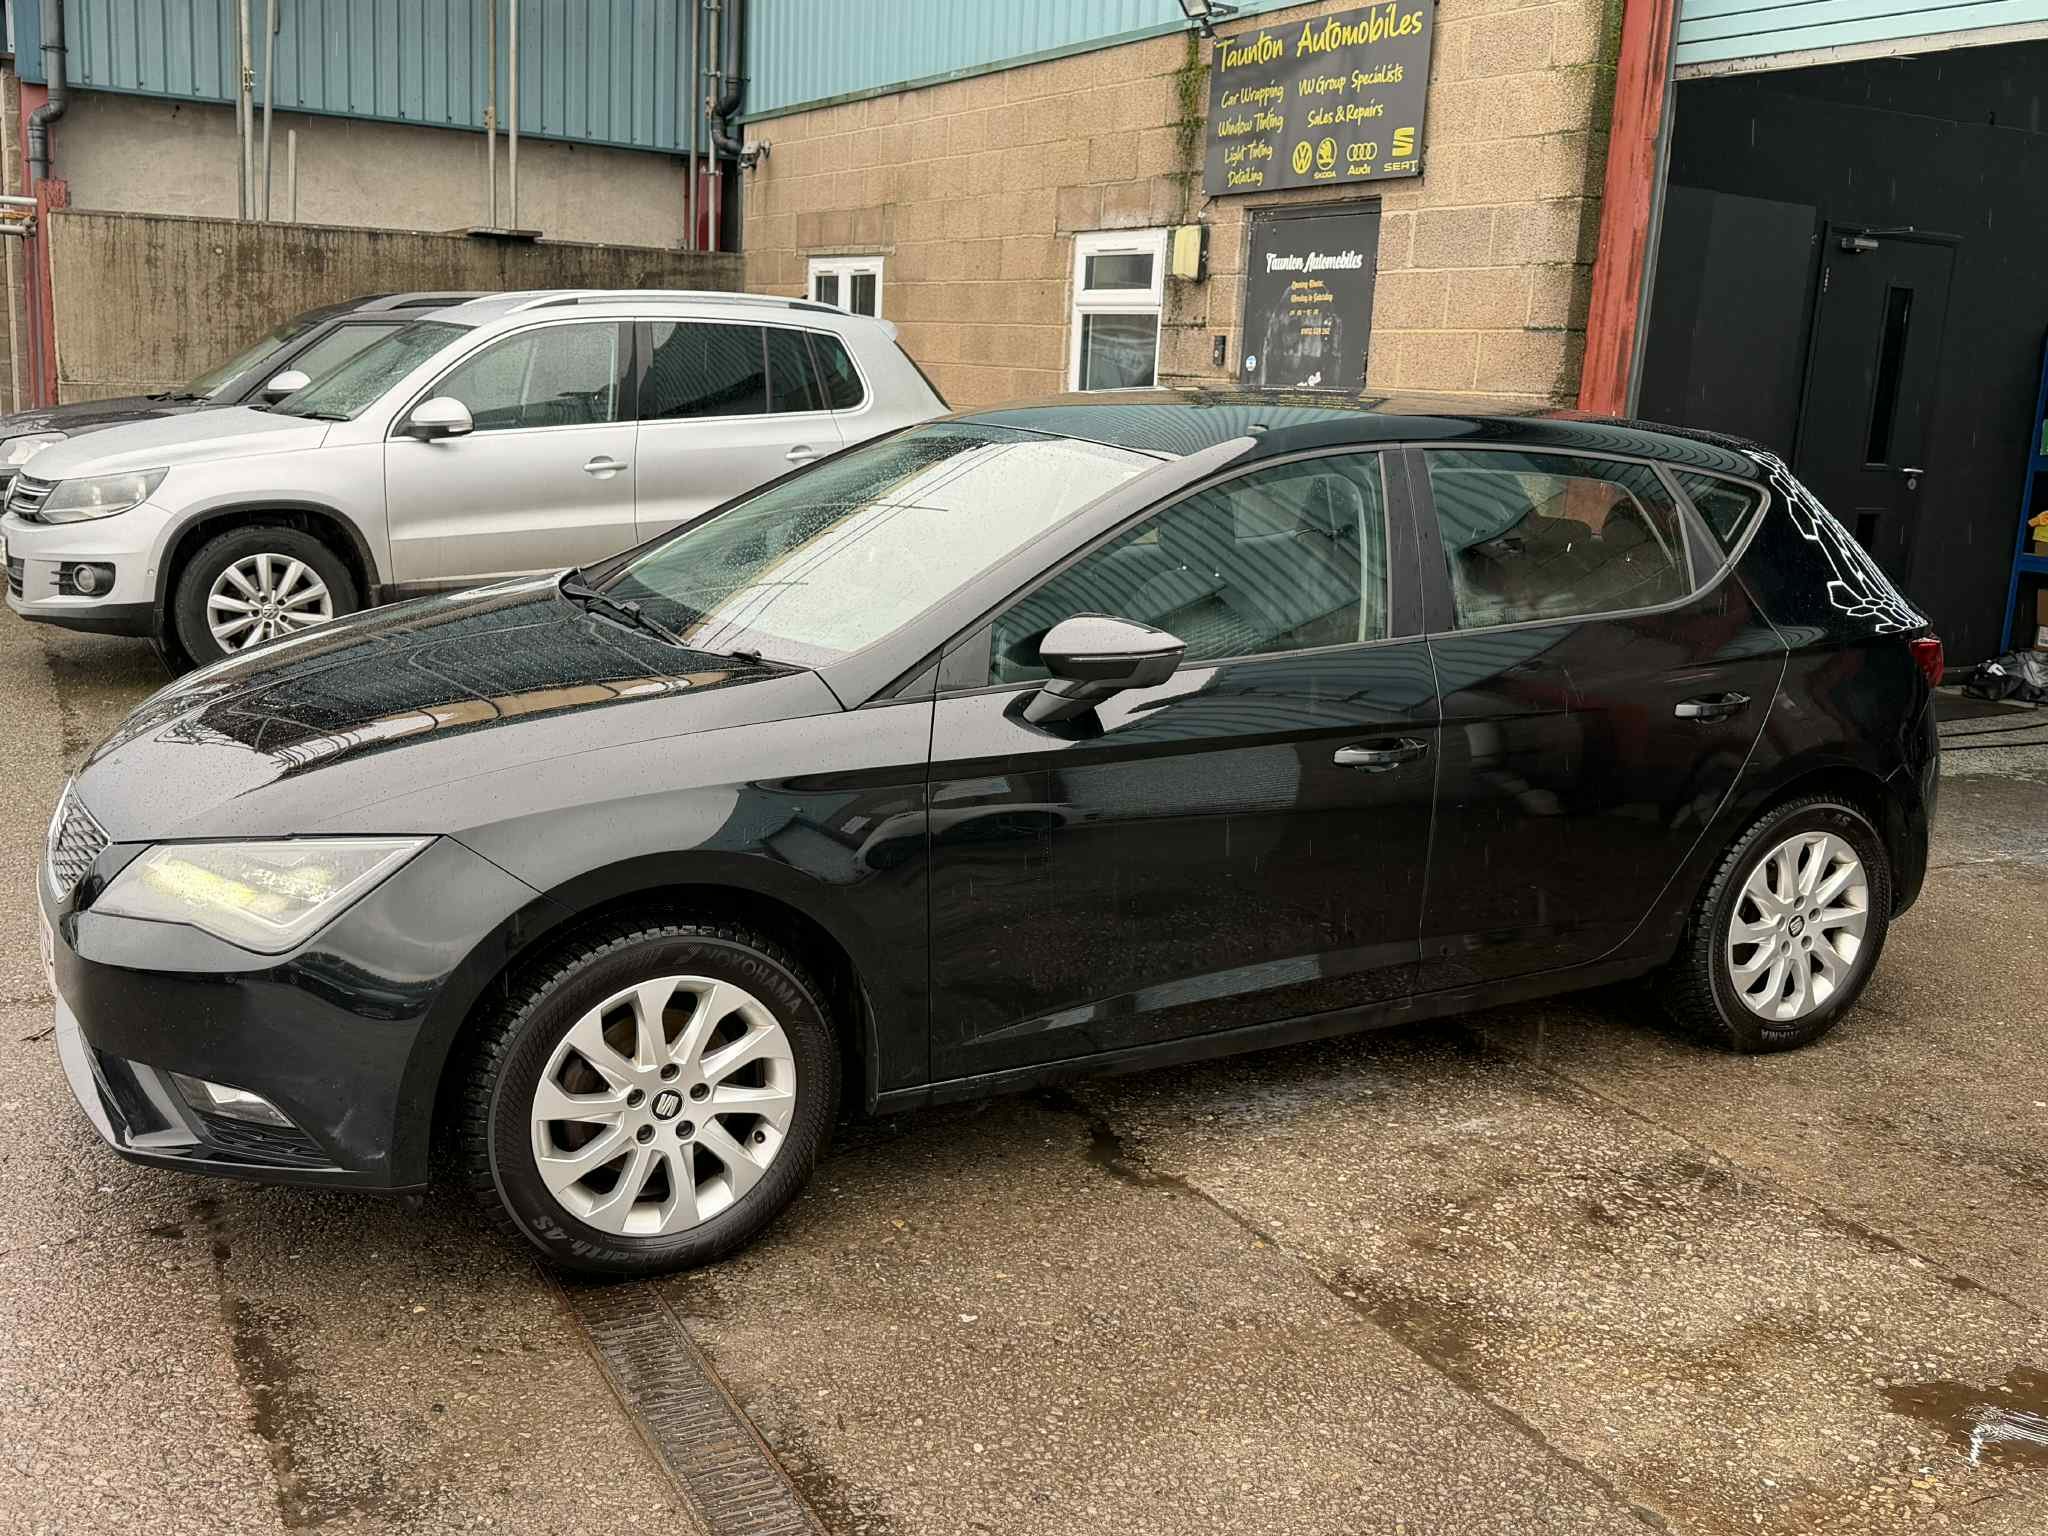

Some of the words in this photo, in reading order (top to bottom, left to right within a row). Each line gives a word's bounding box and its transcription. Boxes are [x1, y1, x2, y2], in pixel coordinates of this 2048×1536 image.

[1215, 31, 1283, 72] Taunton
[1296, 3, 1424, 57] Automobiles
[1298, 78, 1316, 96] VW
[1316, 74, 1346, 95] Group
[1351, 63, 1404, 93] Specialists
[1221, 91, 1240, 108] Car
[1240, 80, 1284, 107] Wrapping
[1218, 113, 1253, 137] Window
[1253, 107, 1284, 133] Tinting
[1307, 107, 1334, 127] Sales
[1335, 105, 1345, 123] &
[1346, 98, 1384, 126] Repairs
[1224, 144, 1247, 166] Light
[1247, 139, 1273, 160] Tinting
[1227, 166, 1264, 188] Detailing
[1347, 164, 1372, 176] Audi
[1383, 160, 1419, 173] SEAT
[1266, 252, 1304, 273] Taunton
[1302, 250, 1363, 273] Automobiles
